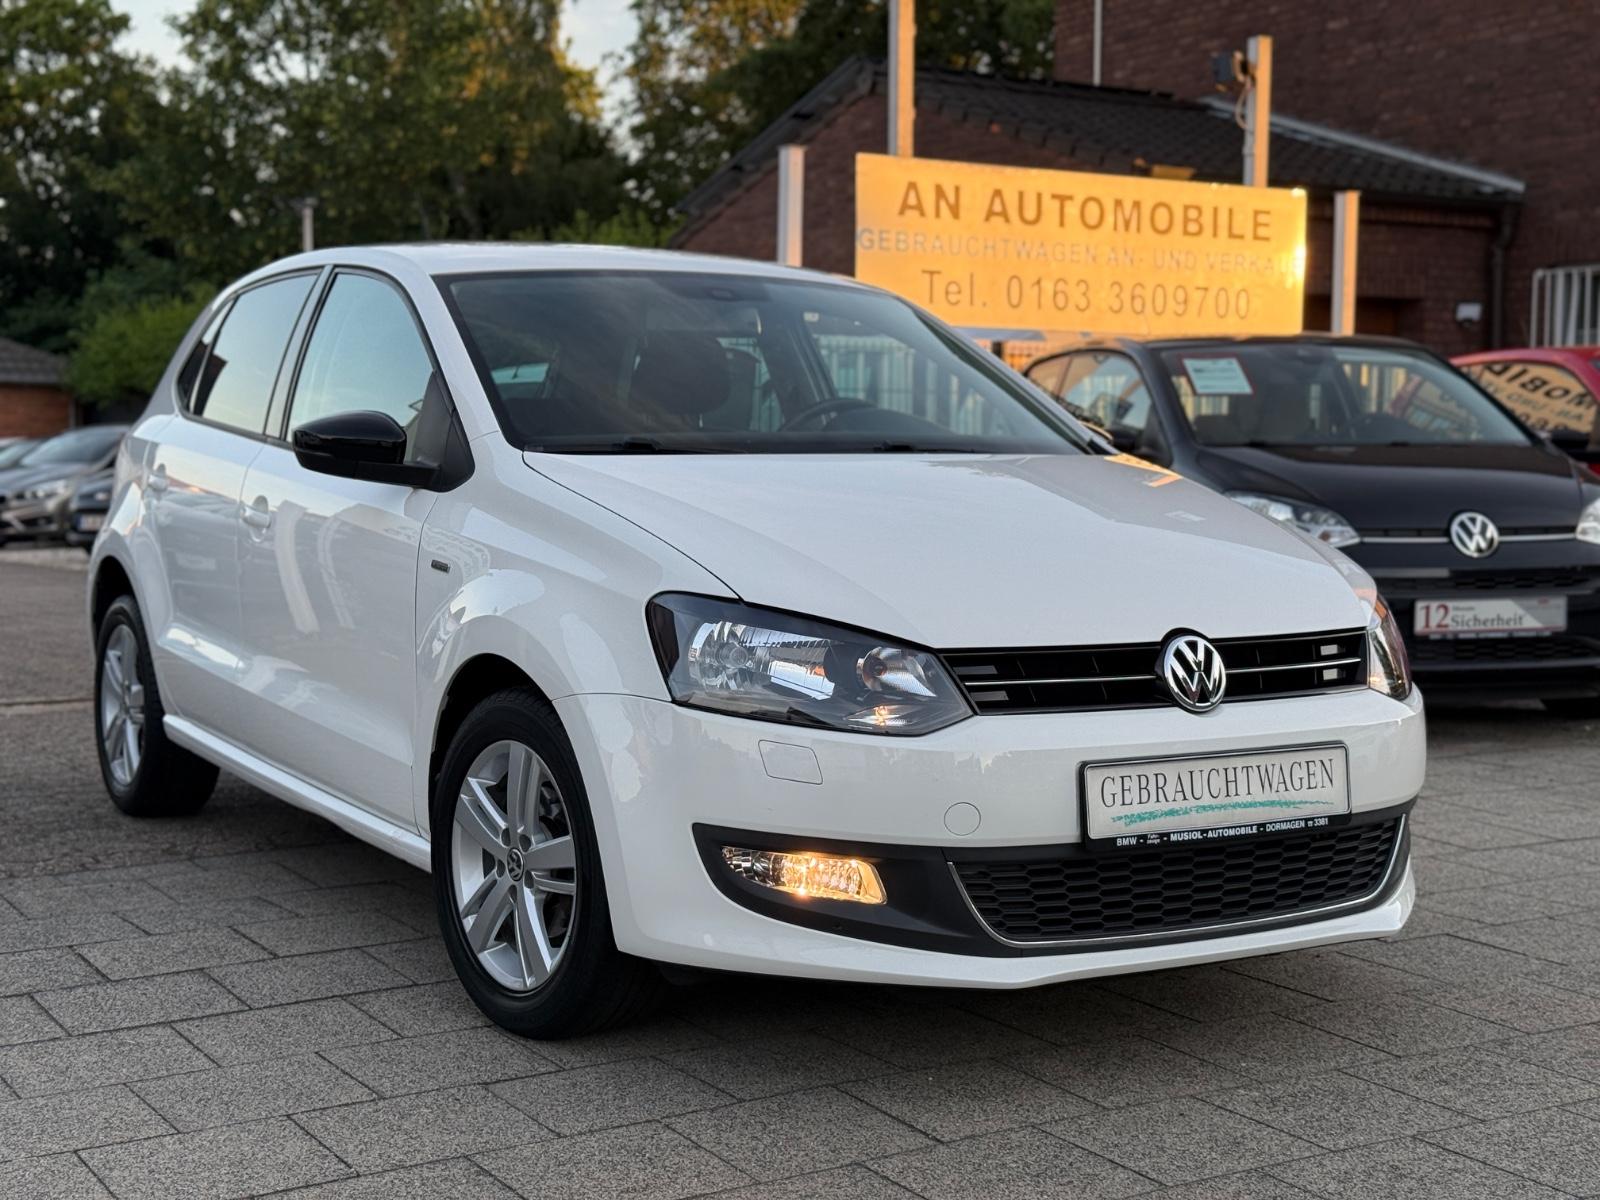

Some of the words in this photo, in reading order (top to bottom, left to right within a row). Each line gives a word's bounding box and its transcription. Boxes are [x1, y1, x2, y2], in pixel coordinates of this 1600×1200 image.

[898, 180, 961, 220] AN
[984, 188, 1272, 242] AUTOMOBILE
[857, 226, 1097, 264] GEBRAUCHTWAGEN
[1152, 248, 1197, 270] UND
[921, 269, 988, 308] Tel.
[1006, 273, 1091, 313] 0163
[1109, 280, 1250, 320] 3609700
[1419, 602, 1450, 629] 12
[1450, 612, 1524, 629] Sicherheit
[1100, 758, 1336, 808] GEBRAUCHTWAGEN
[1116, 836, 1138, 847] BMW
[1170, 825, 1258, 842] MUSIOL-AUTOMOBILE
[1265, 820, 1305, 832] DORMAGEN
